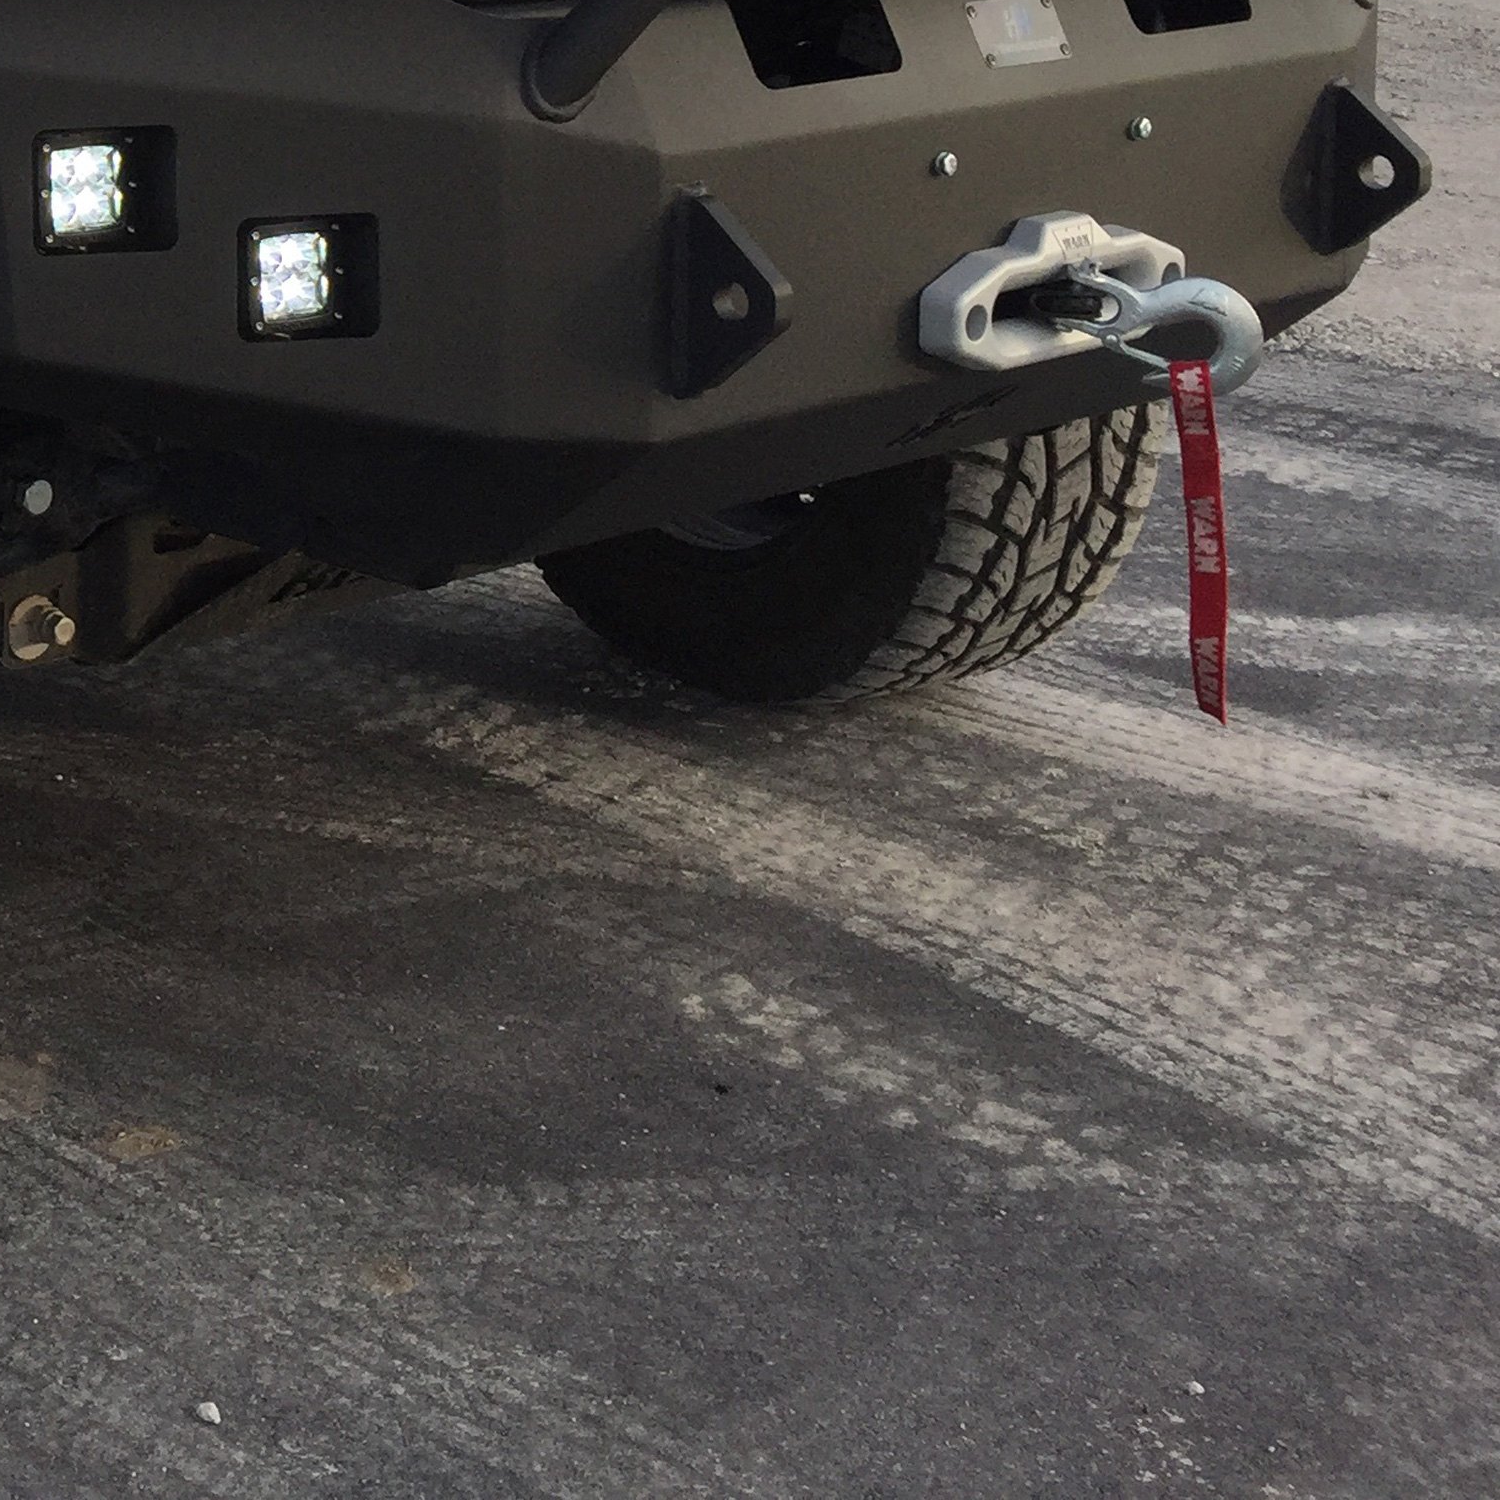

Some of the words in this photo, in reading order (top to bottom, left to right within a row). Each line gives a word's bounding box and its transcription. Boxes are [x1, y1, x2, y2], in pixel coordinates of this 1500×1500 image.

[1176, 366, 1210, 435] WARN
[1190, 496, 1221, 574] WARN
[1193, 636, 1220, 708] WARN
